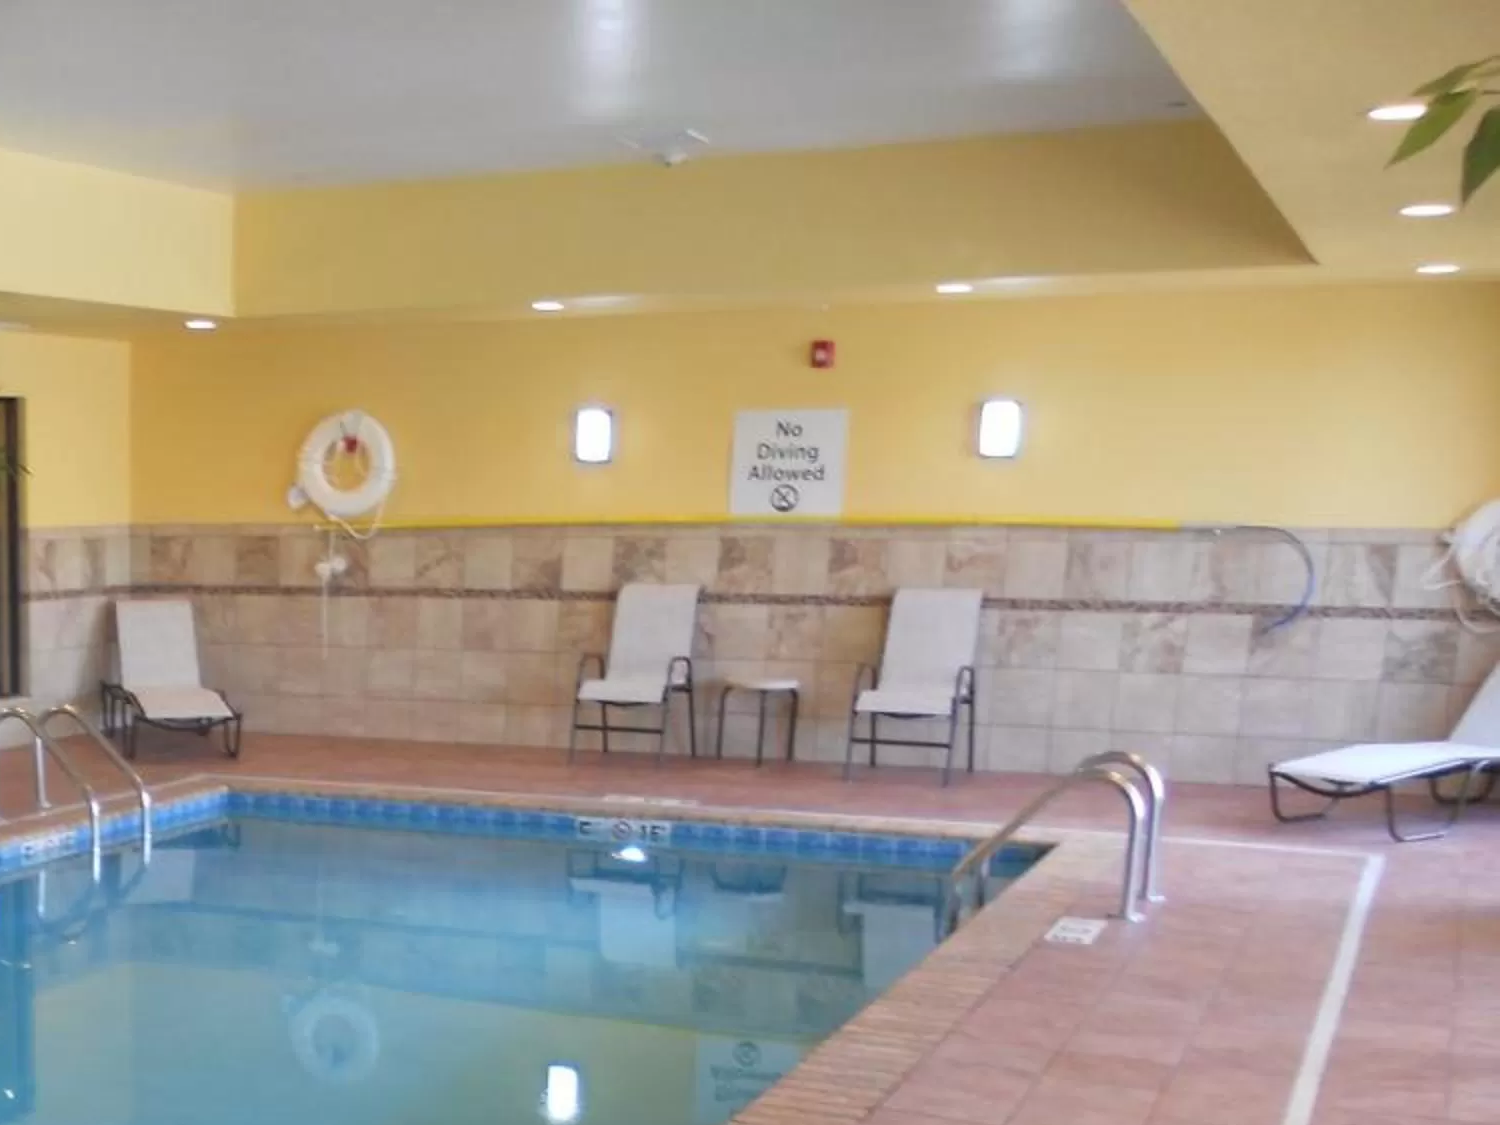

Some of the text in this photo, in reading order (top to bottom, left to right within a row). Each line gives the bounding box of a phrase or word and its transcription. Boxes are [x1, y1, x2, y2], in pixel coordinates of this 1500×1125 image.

[776, 419, 803, 437] No
[756, 442, 820, 464] Diving
[747, 464, 825, 481] Allowed
